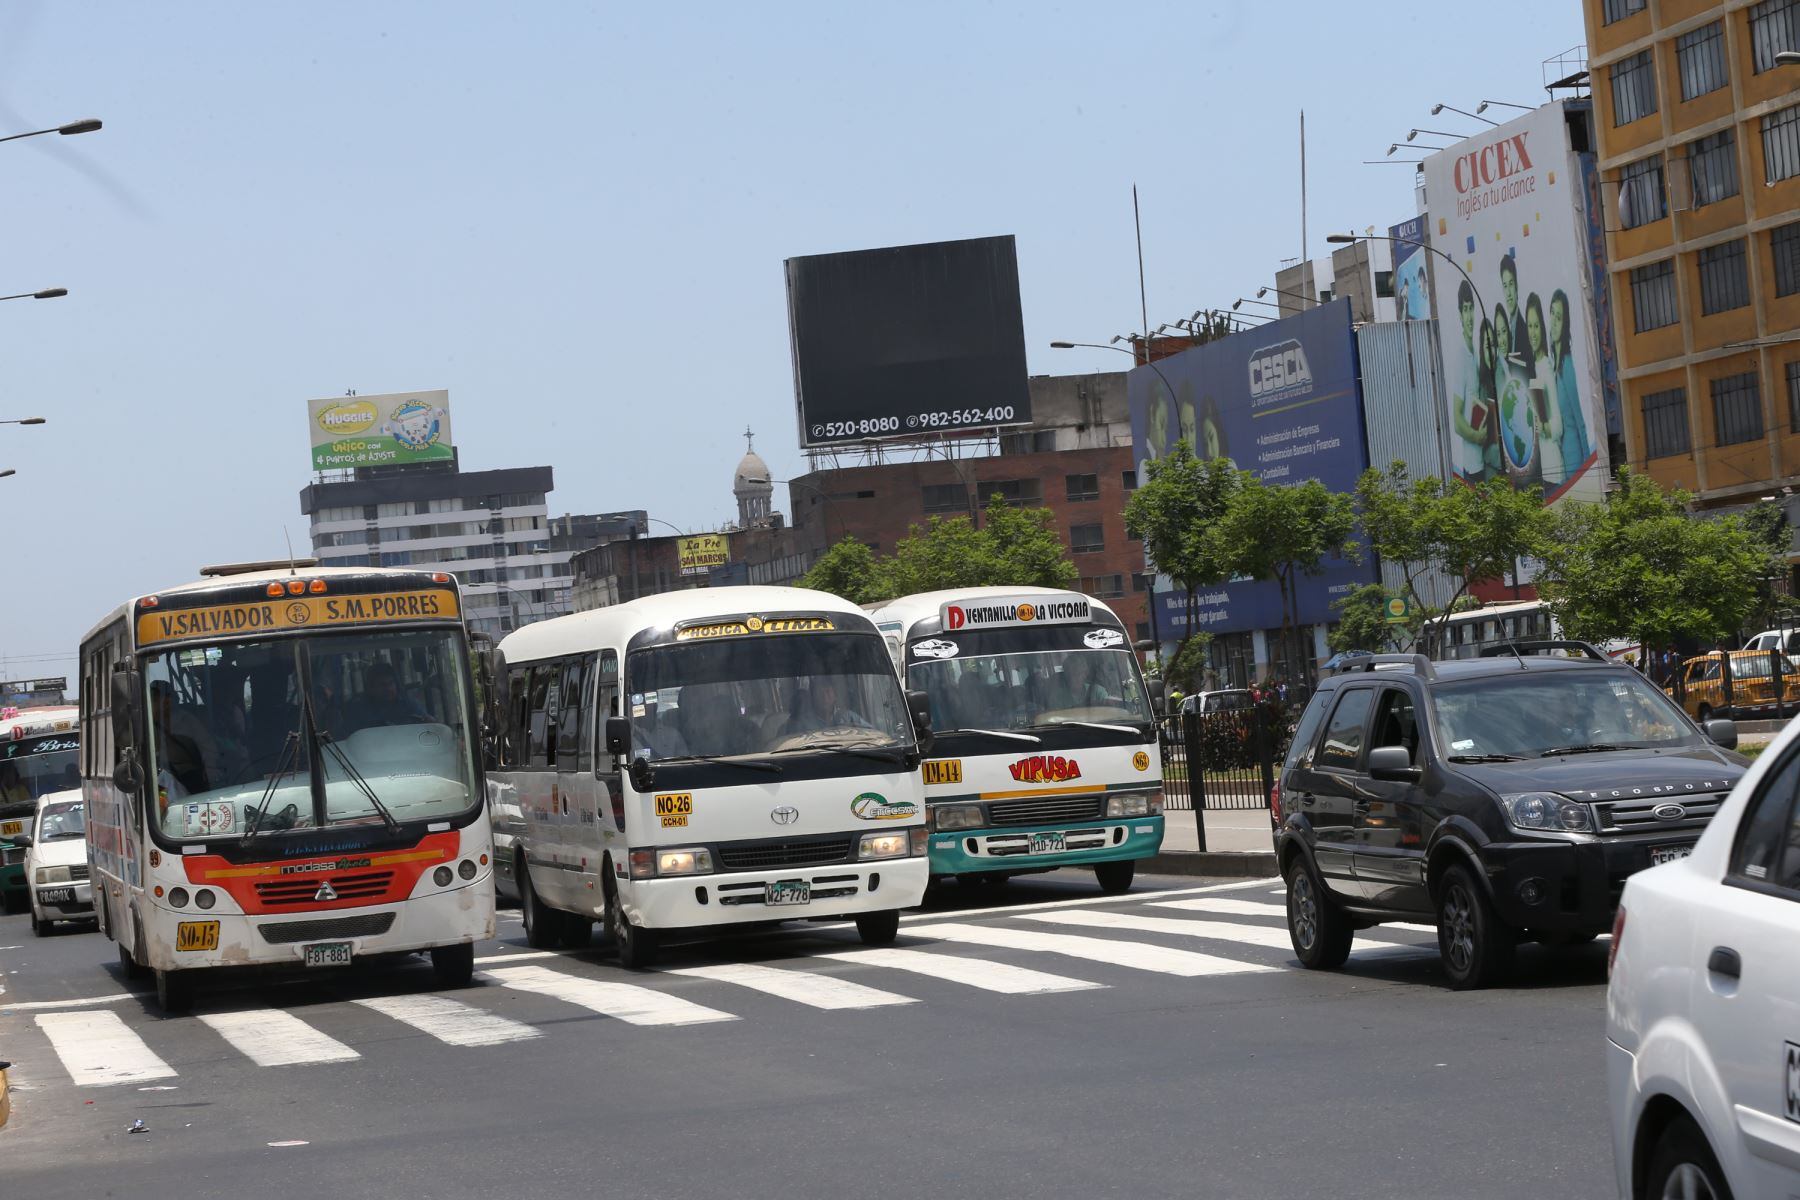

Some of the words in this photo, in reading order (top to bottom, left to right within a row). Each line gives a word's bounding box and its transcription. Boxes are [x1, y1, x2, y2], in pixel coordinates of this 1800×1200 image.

[1454, 132, 1533, 194] CICEX
[1457, 191, 1481, 220] Inglés
[1483, 196, 1489, 209] a
[1490, 188, 1499, 206] tu
[1501, 175, 1536, 203] alcance
[1249, 345, 1313, 397] CESCA
[826, 416, 899, 437] 520-8080
[919, 406, 1014, 427] 982-562-400
[697, 553, 727, 565] MARCOS
[160, 606, 274, 636] V.SALVADOR
[770, 620, 828, 631] LIMA
[948, 606, 965, 629] D
[965, 605, 1017, 624] VENTANILLA
[1035, 605, 1046, 620] LA
[1048, 601, 1088, 620] VICTORIA
[1008, 755, 1082, 783] VIPUSA
[1590, 780, 1729, 799] ECOSPORT
[663, 817, 686, 827] CCH-01
[281, 860, 337, 876] modasa
[307, 949, 349, 964] F8T-881
